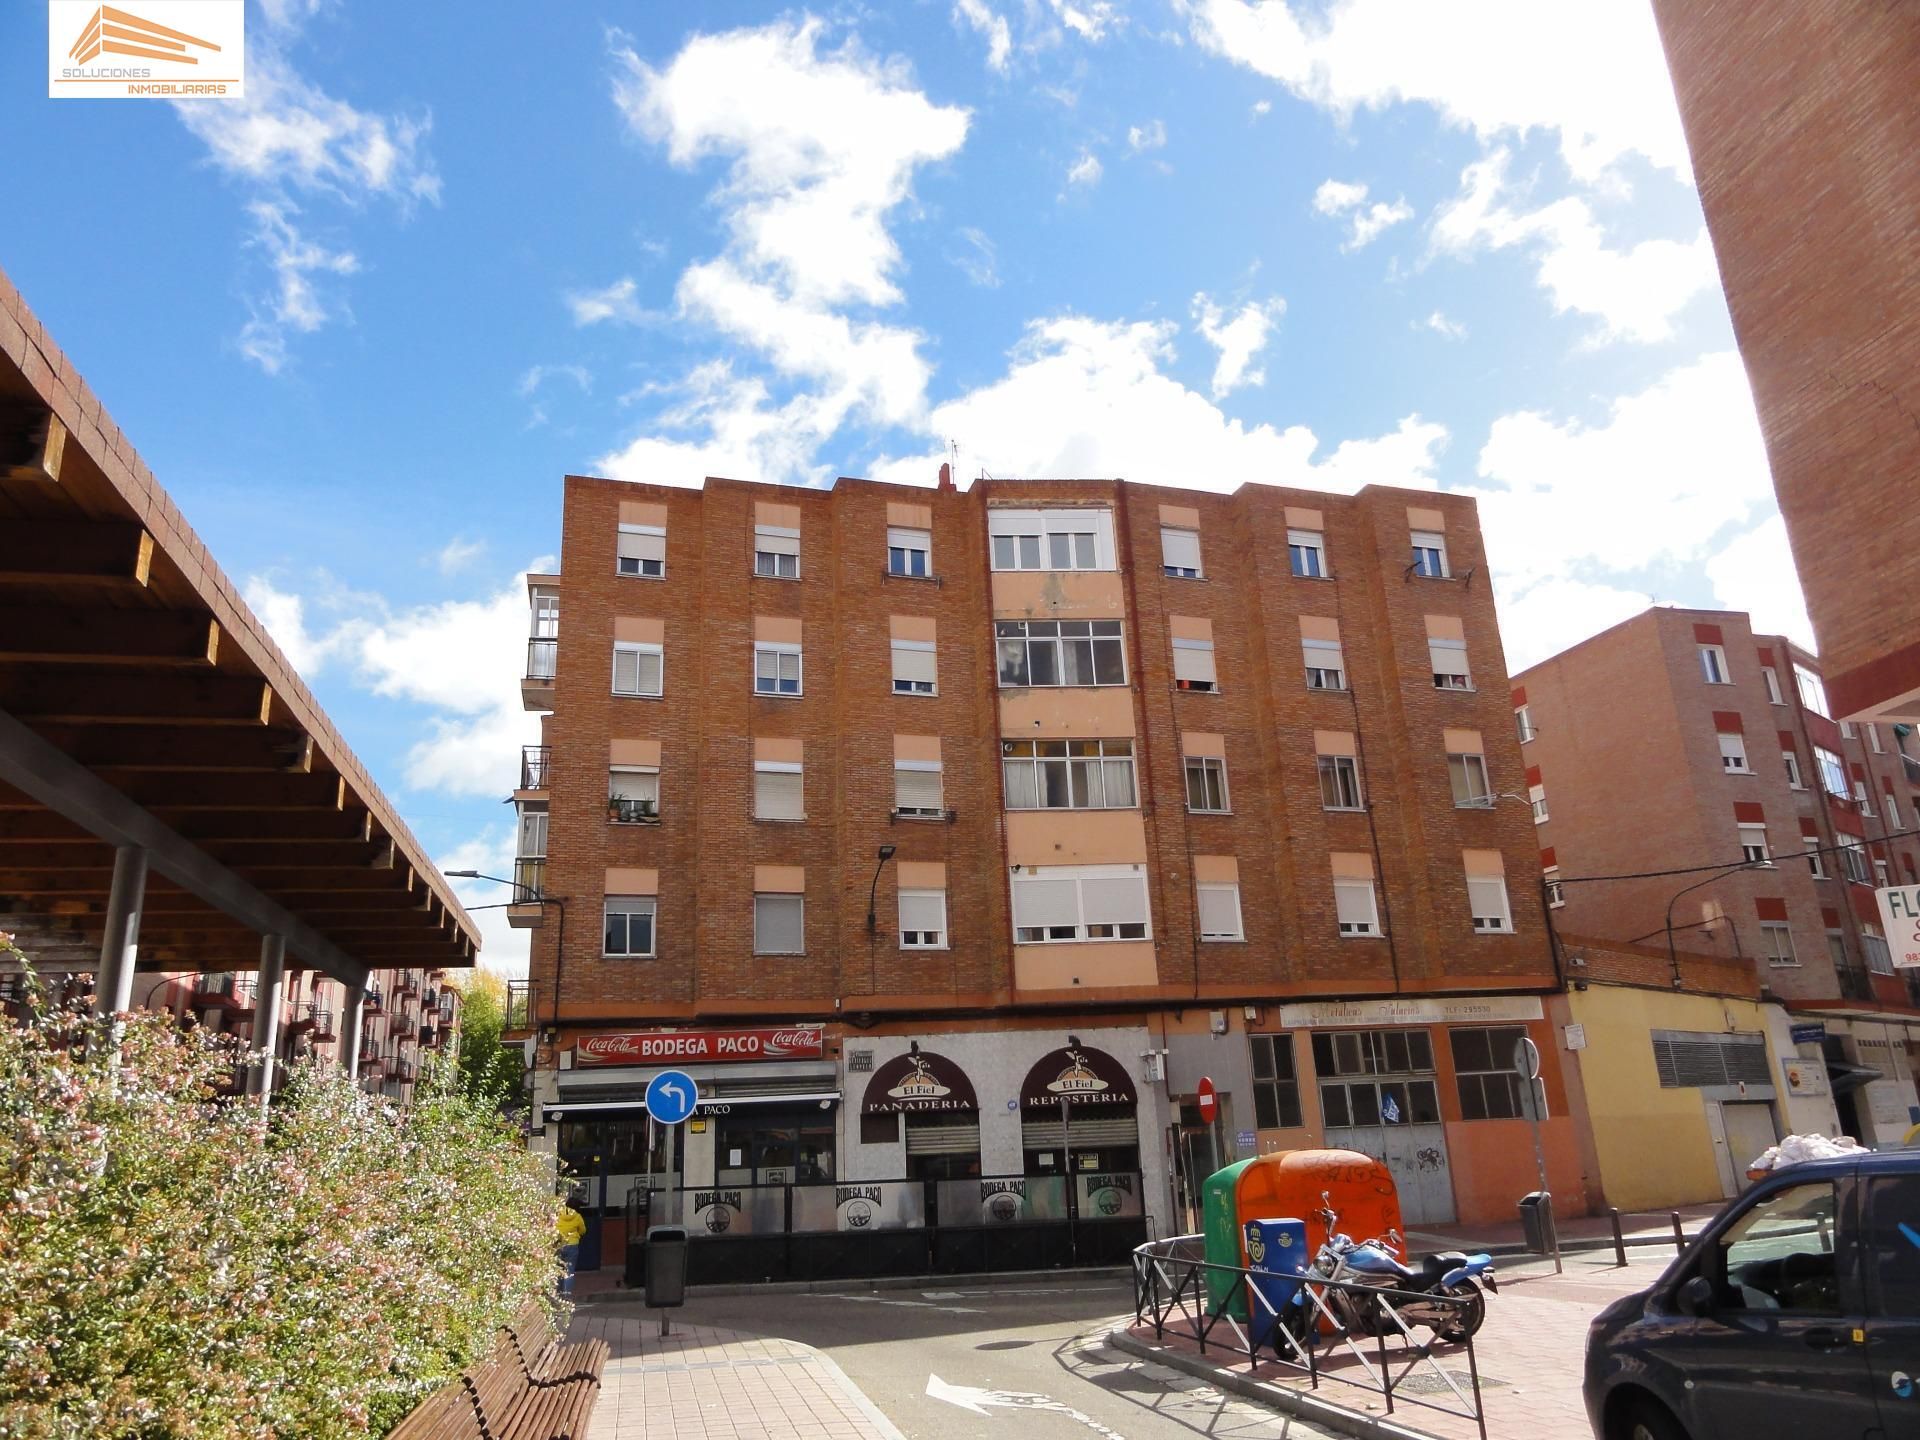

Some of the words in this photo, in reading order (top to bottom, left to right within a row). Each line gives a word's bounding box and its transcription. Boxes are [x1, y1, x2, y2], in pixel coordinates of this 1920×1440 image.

[1887, 890, 1920, 919] FL
[642, 1038, 708, 1056] BODEGA
[717, 1036, 759, 1053] PACO
[903, 1086, 914, 1095] El
[916, 1084, 935, 1095] Fiel
[1062, 1080, 1073, 1089] El
[1075, 1079, 1093, 1088] Fiel
[704, 1104, 731, 1115] PACO
[869, 1099, 971, 1112] PANADERIA
[835, 1186, 862, 1209] BODEGA
[865, 1186, 882, 1208] PACO
[980, 1181, 1007, 1203] BODEGA
[1009, 1180, 1026, 1201] PACO
[694, 1191, 722, 1215] BODEGA
[724, 1191, 742, 1213] PACO
